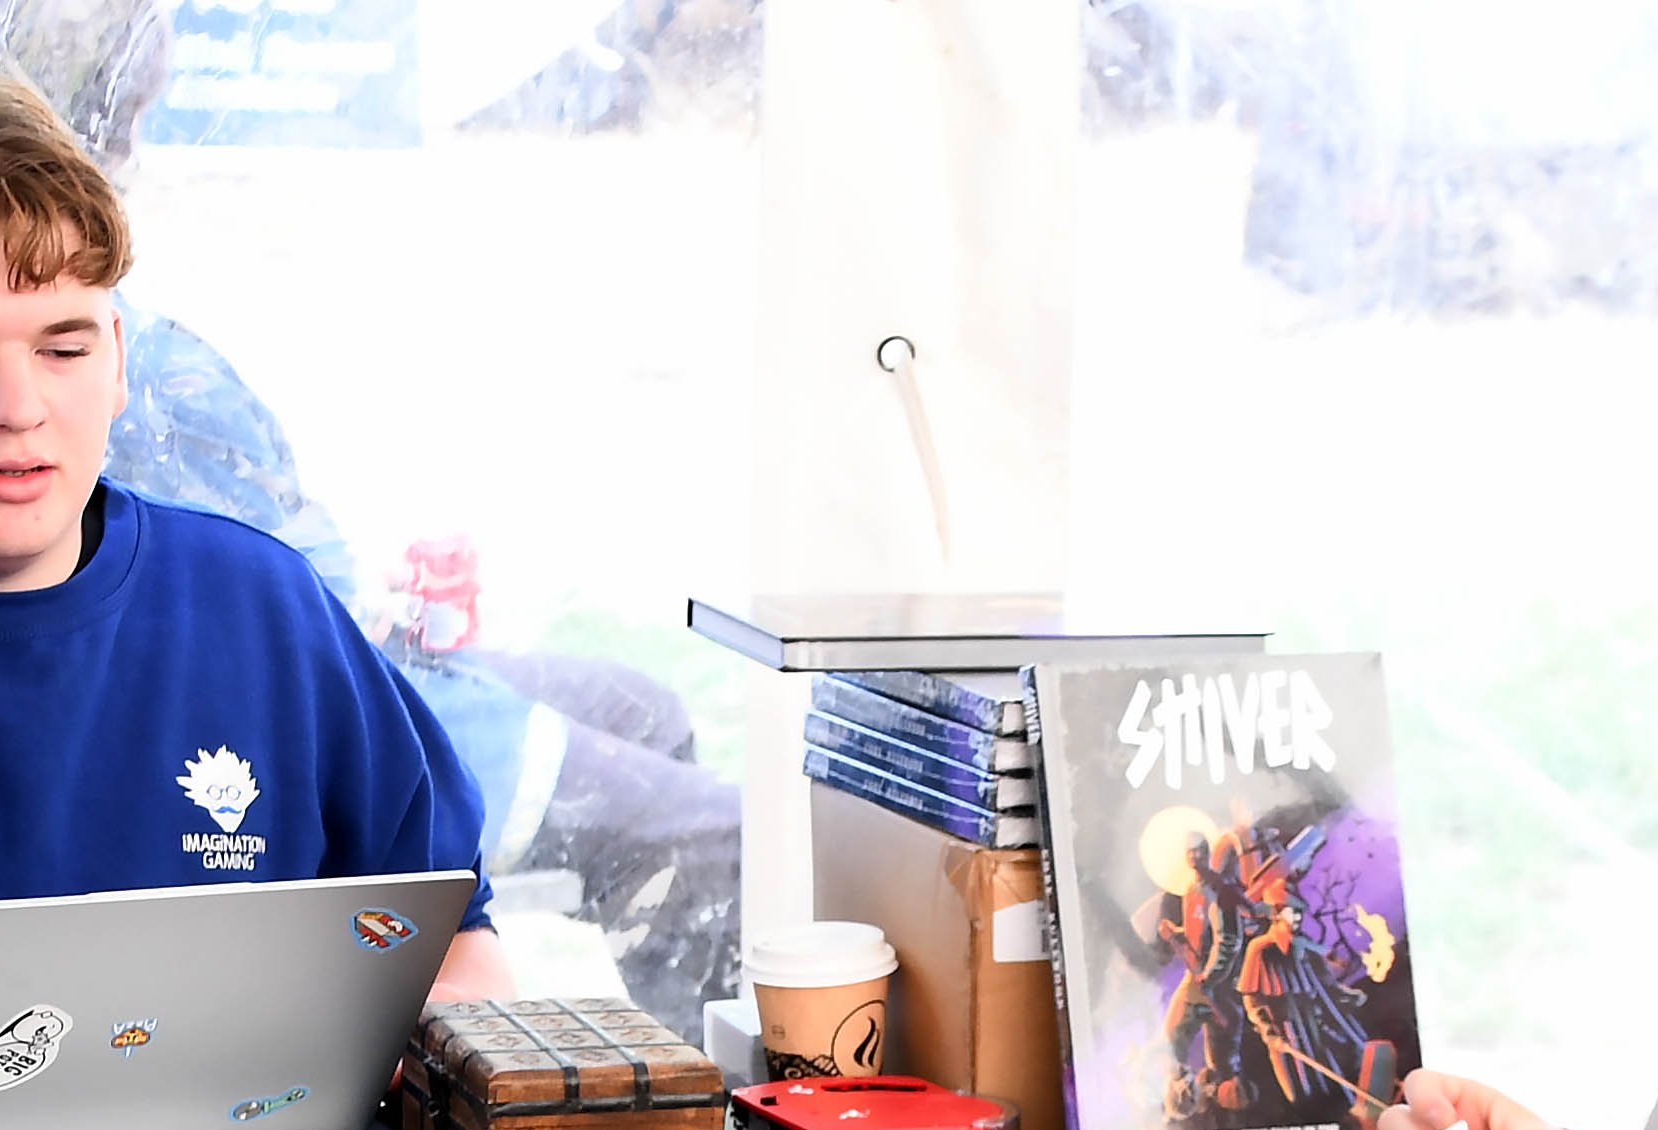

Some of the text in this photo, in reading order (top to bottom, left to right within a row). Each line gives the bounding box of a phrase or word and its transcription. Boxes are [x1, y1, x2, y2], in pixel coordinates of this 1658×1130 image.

[1118, 670, 1337, 789] SHIVER
[203, 852, 255, 871] GAMING
[4, 1055, 37, 1076] BIG
